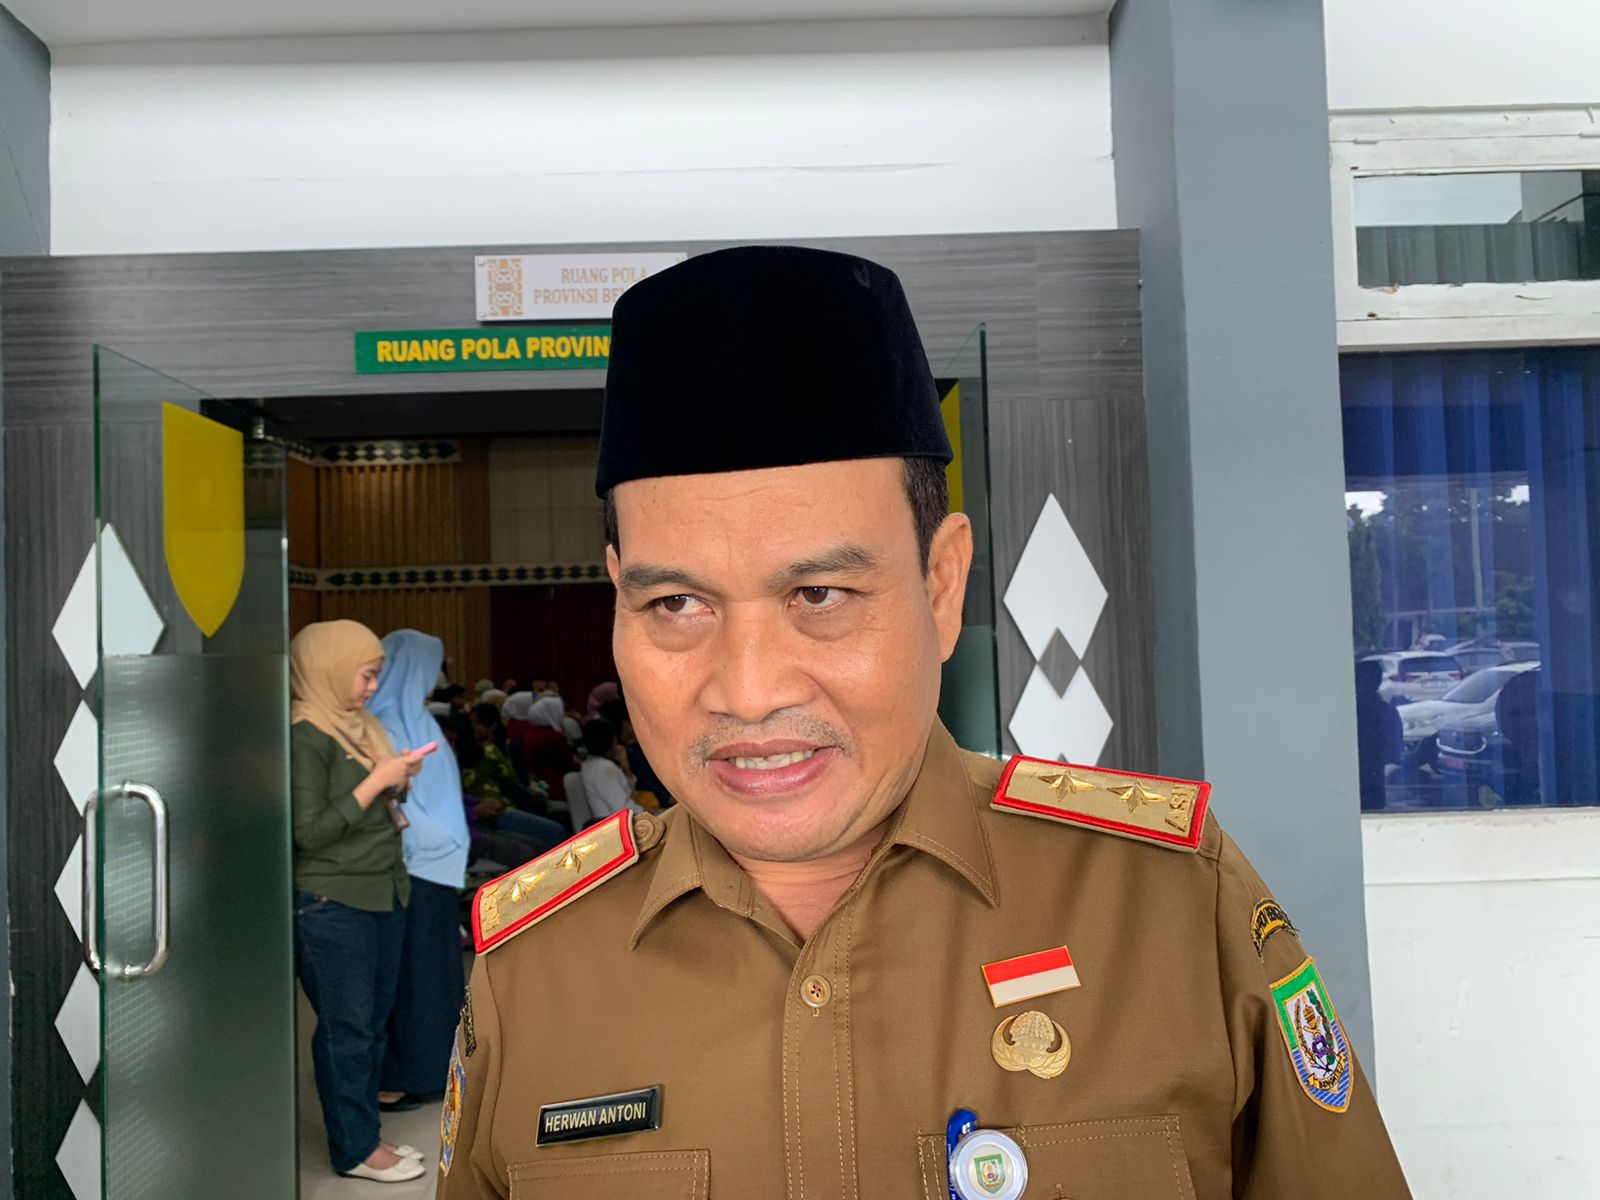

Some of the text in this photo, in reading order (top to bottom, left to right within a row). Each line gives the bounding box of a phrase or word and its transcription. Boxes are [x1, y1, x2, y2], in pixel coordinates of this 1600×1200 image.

[561, 267, 648, 283] RUANG POLA
[533, 287, 598, 304] PROVINSI
[377, 336, 609, 362] RUANG POLA PROVIN
[545, 1102, 646, 1133] HERWAN ANTONI
